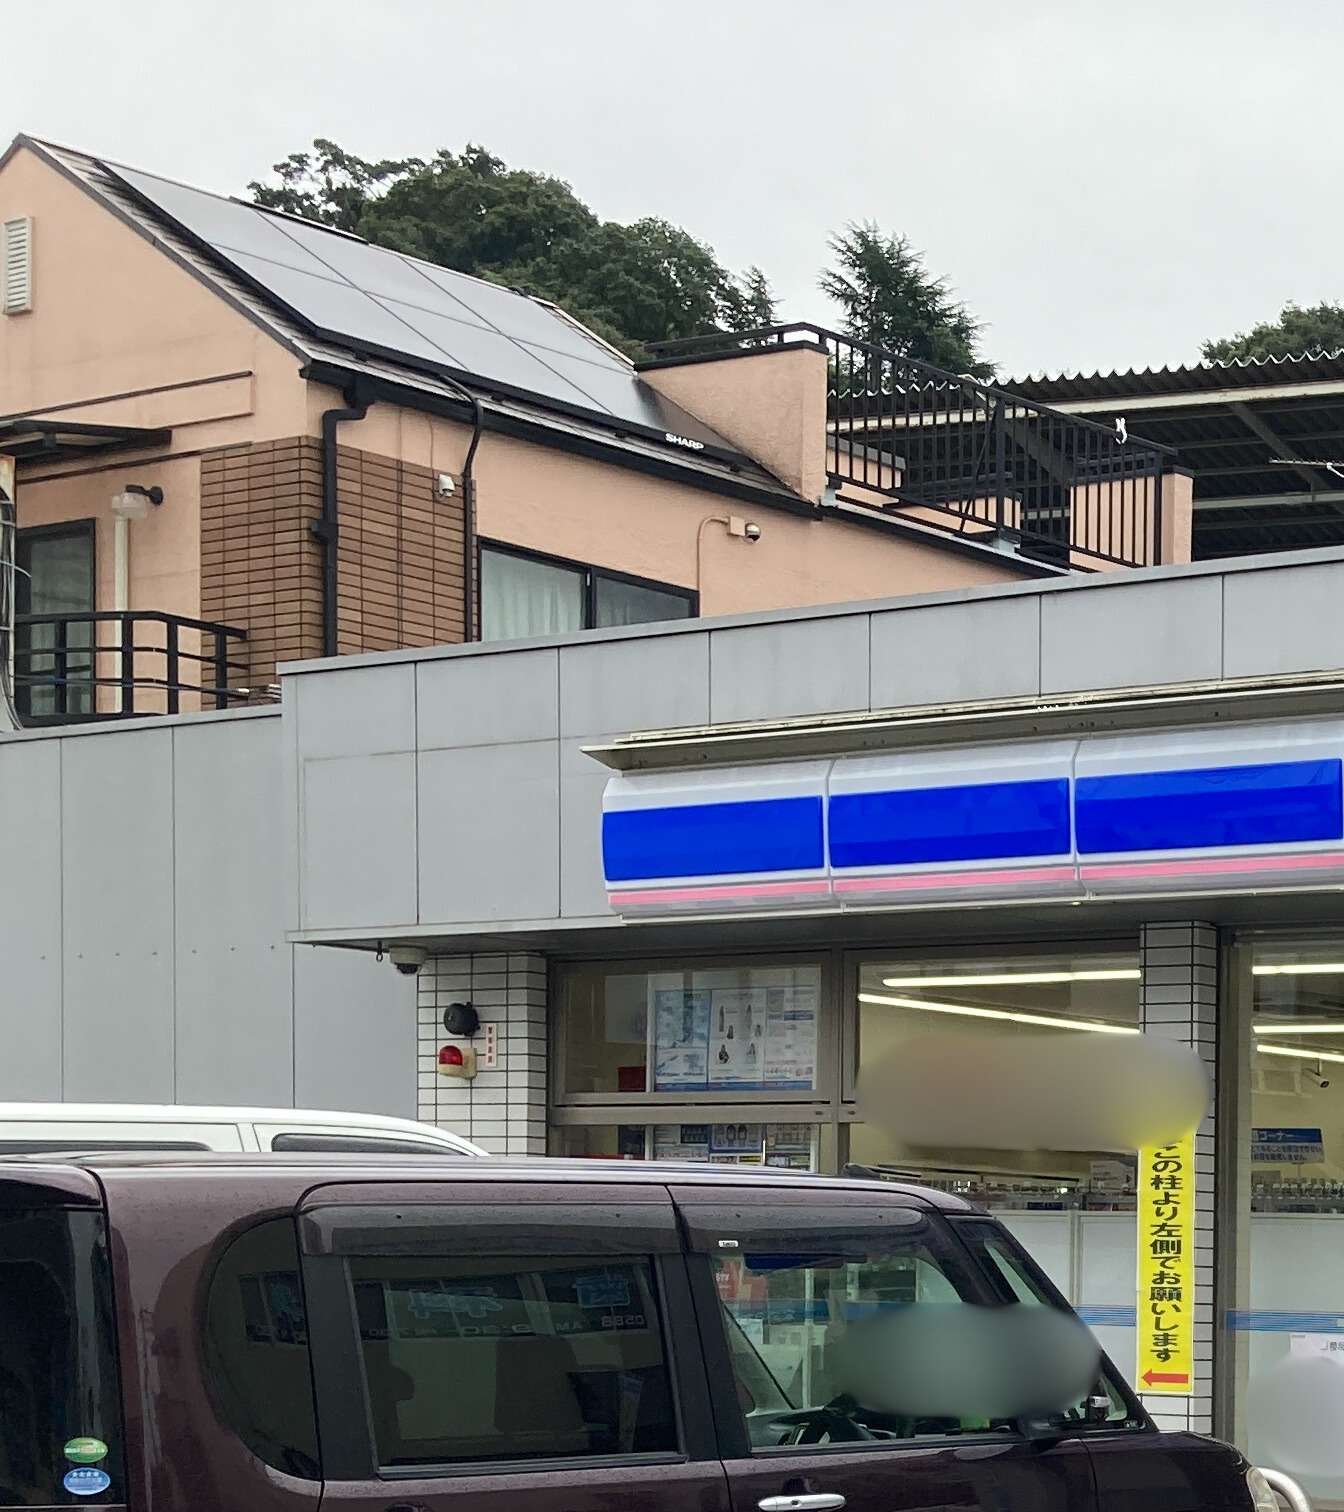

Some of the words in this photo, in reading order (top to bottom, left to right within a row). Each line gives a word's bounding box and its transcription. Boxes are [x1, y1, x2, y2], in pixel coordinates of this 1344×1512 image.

[1150, 1145, 1183, 1362] この柱より左側でお願いします
